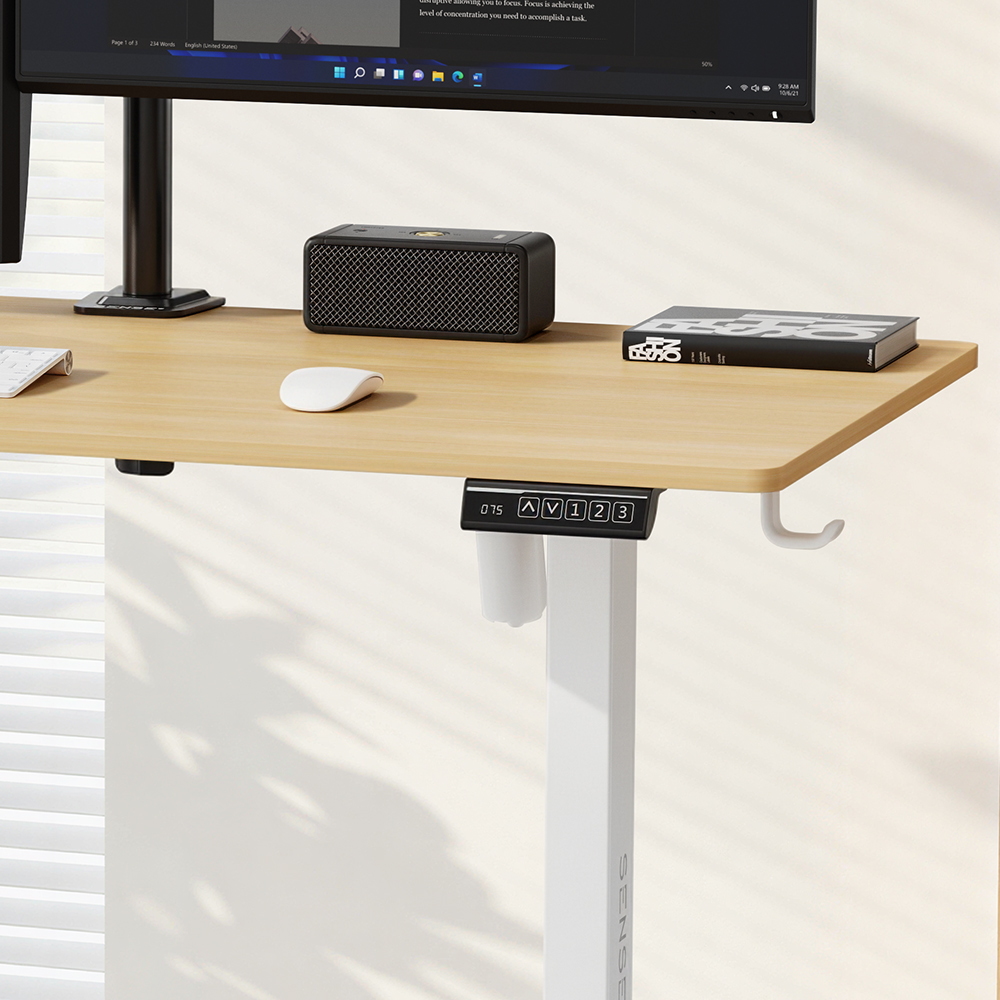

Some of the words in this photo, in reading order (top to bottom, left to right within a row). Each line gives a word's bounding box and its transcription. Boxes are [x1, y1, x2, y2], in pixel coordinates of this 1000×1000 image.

[552, 1, 583, 10] achieving
[528, 14, 565, 22] accomplish
[480, 503, 503, 516] 075
[571, 503, 580, 517] 1
[594, 505, 604, 518] 2
[617, 506, 627, 519] 3
